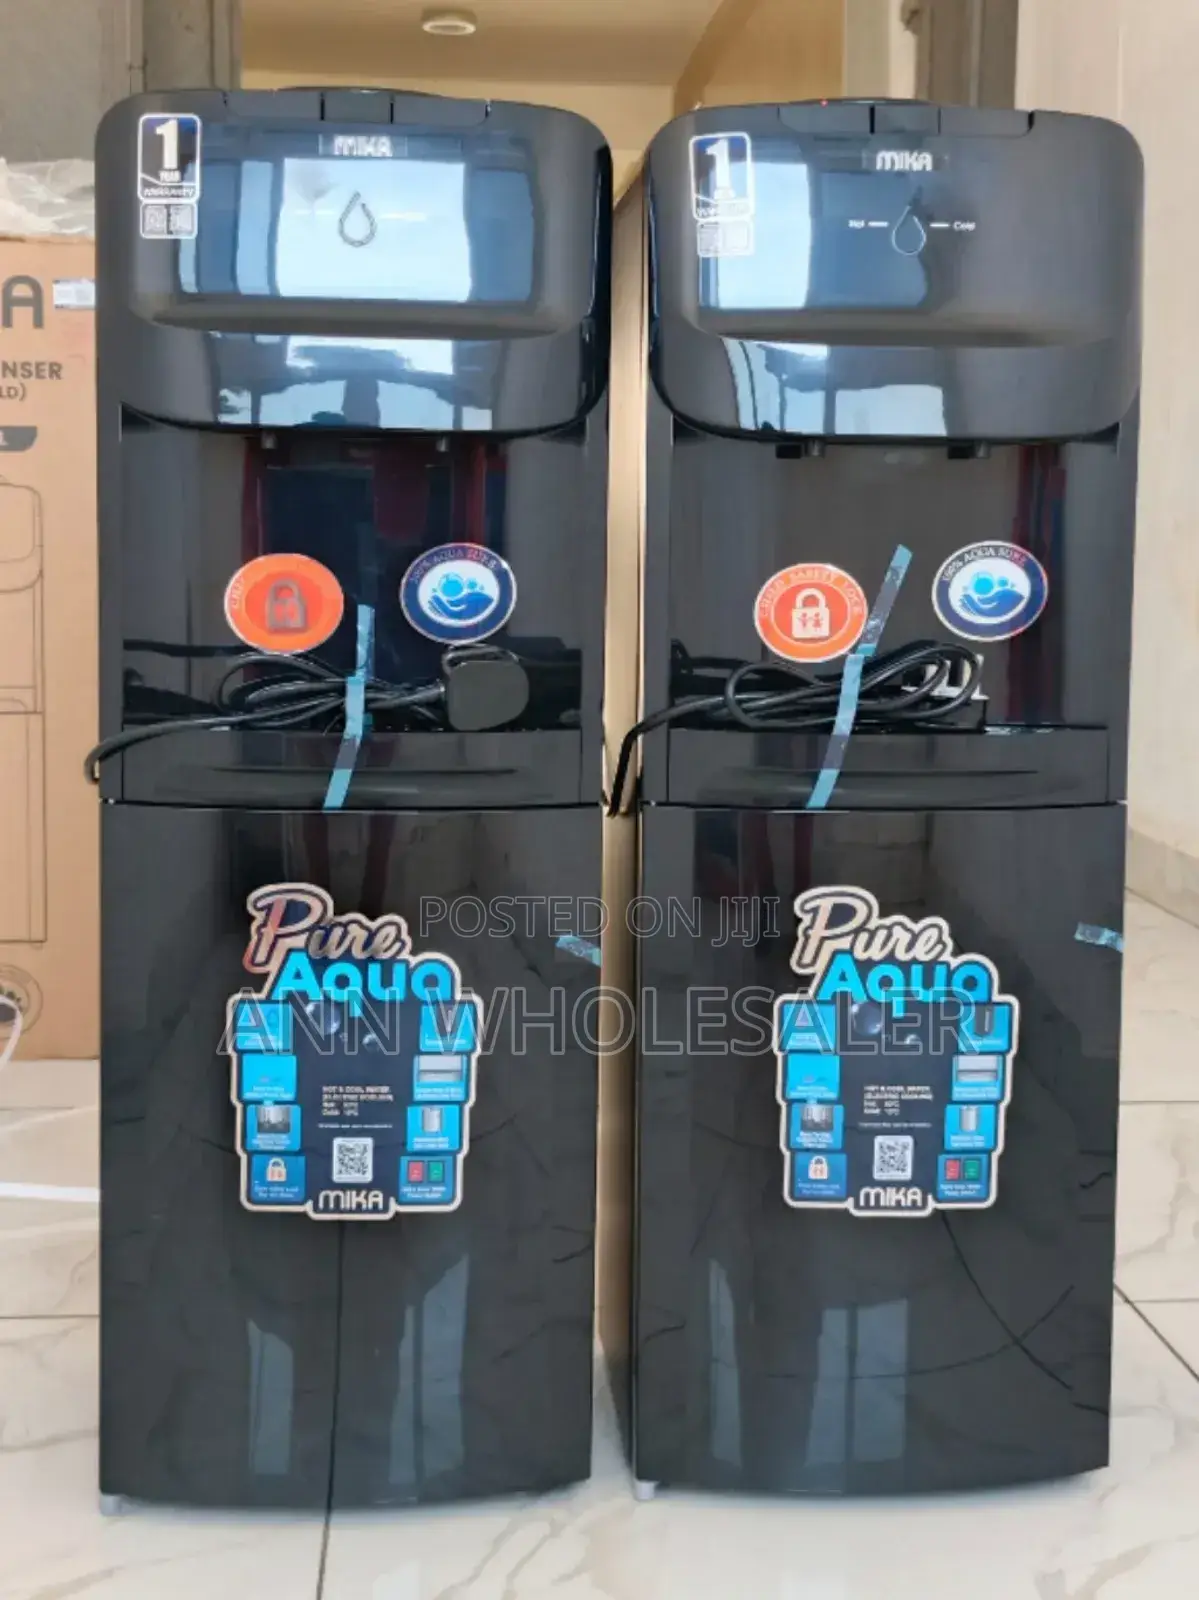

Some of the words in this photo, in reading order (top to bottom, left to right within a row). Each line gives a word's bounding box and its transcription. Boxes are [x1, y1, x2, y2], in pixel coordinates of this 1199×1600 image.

[156, 118, 179, 170] 1
[705, 138, 731, 189] 1
[252, 890, 405, 965] Pure
[799, 893, 945, 967] Pure
[270, 951, 453, 1017] Aqua
[815, 953, 991, 1018] Aqua
